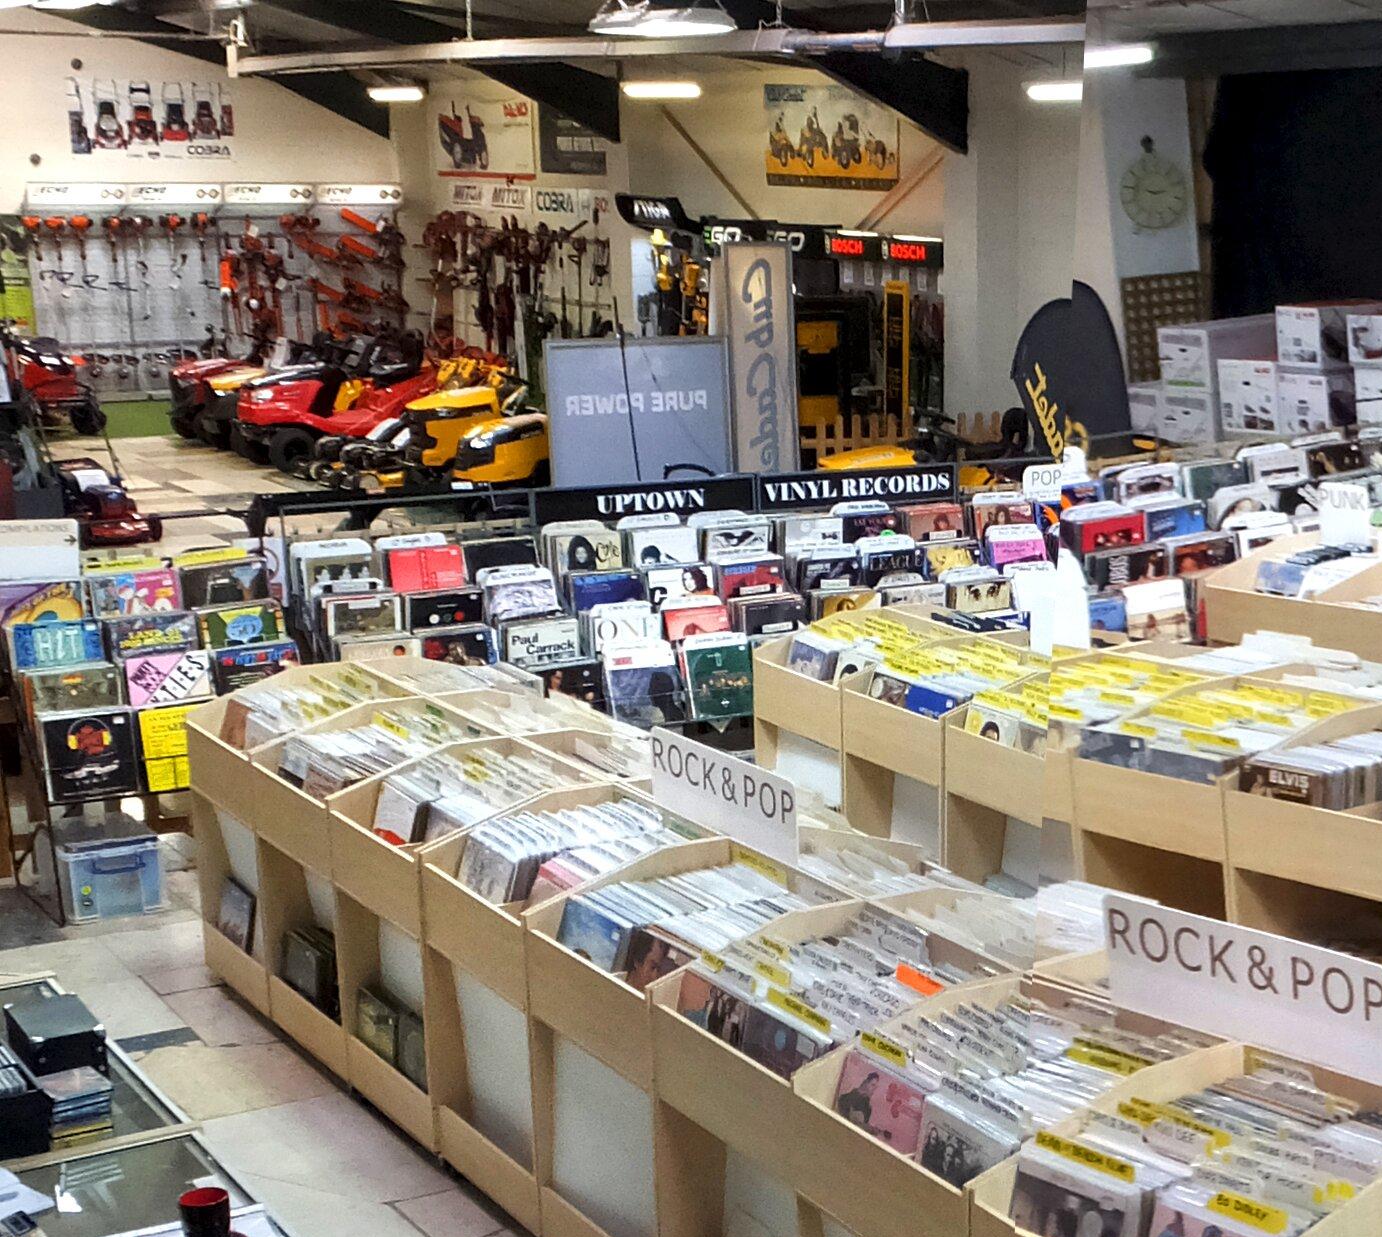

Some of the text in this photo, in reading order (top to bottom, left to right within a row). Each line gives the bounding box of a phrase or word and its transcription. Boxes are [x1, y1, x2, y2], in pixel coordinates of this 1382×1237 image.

[187, 145, 231, 155] COBRA
[535, 190, 574, 212] COBRA
[831, 238, 863, 255] BOSCH
[890, 242, 926, 260] BOSCH
[1031, 470, 1062, 487] POP
[597, 472, 951, 515] UPTOWN VINYL RECORDS
[1319, 488, 1364, 510] PUNK
[511, 634, 540, 650] Paul
[526, 642, 575, 654] Carrack
[1268, 770, 1309, 787] ELVIS
